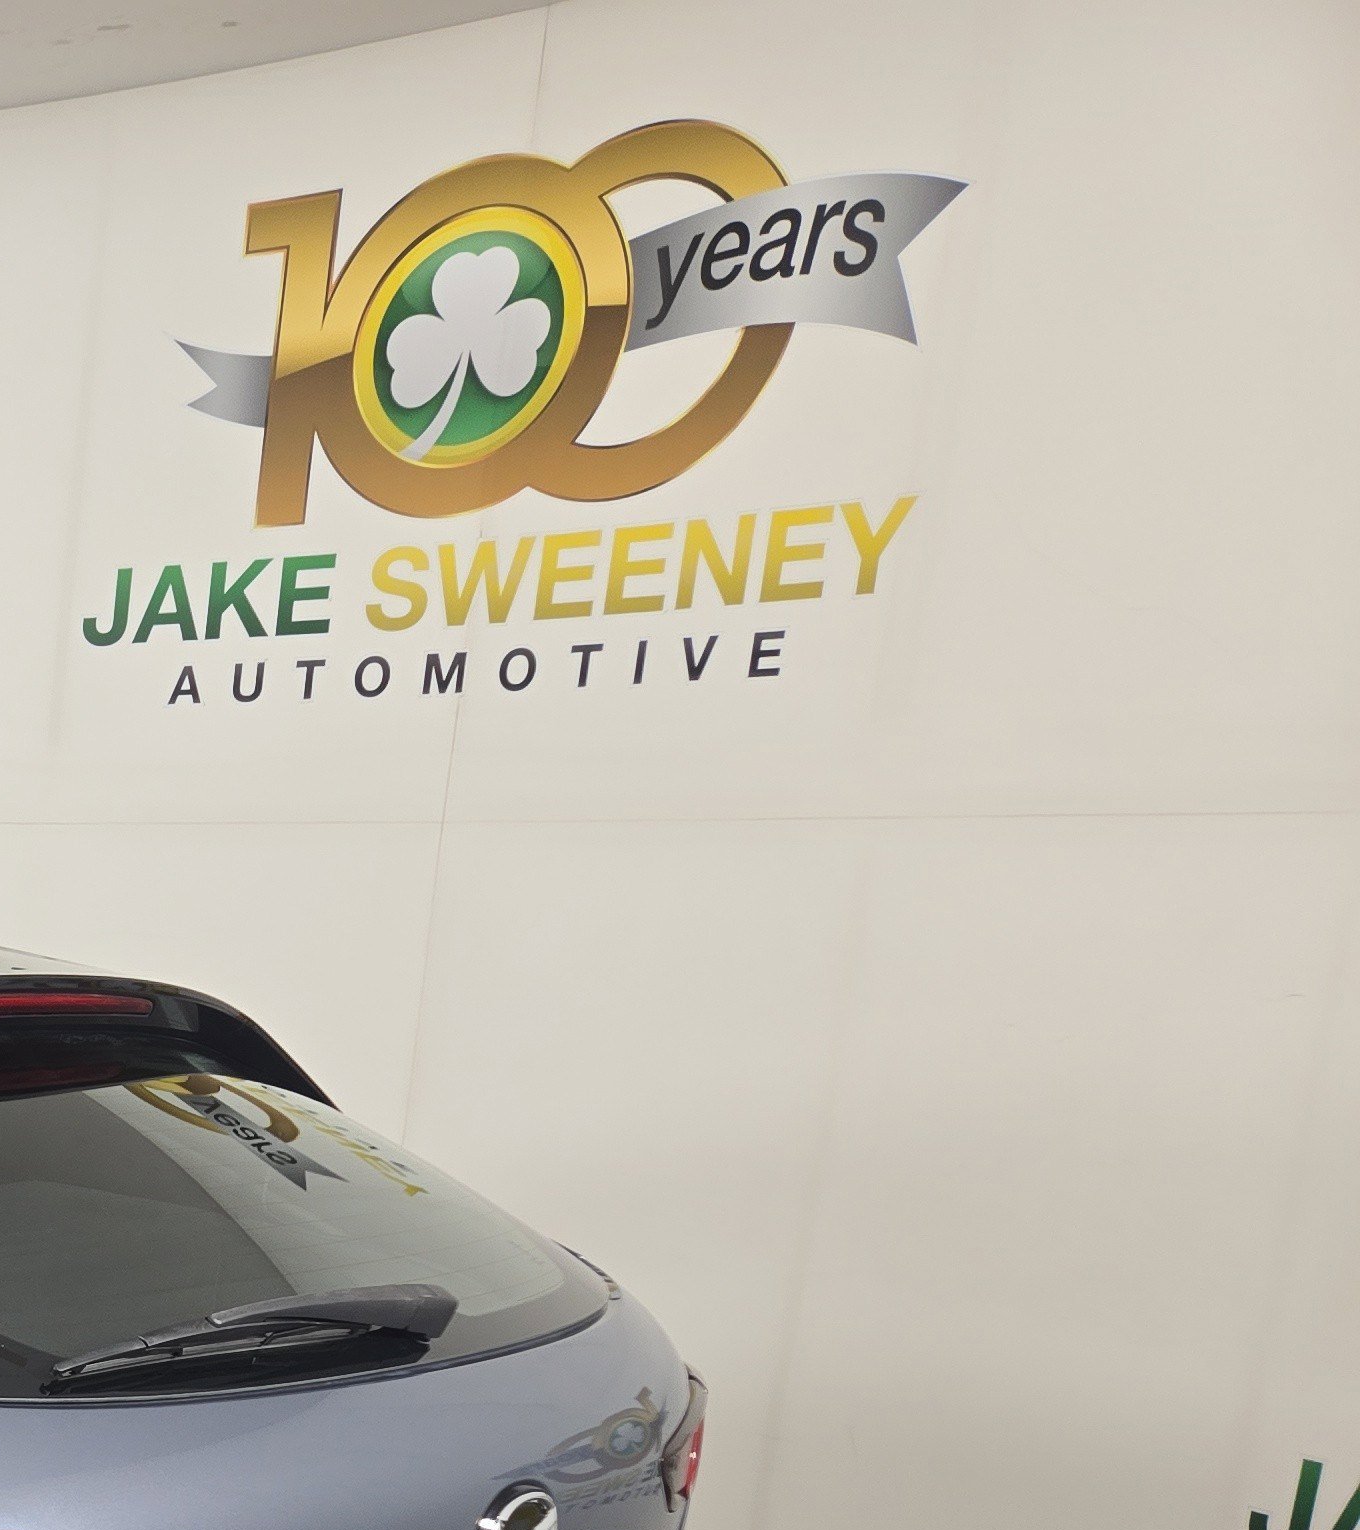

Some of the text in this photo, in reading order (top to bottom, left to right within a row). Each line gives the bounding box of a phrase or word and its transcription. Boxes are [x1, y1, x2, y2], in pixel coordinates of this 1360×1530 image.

[645, 196, 887, 332] years
[81, 494, 919, 647] JAKE SWEENEY
[167, 629, 786, 706] AUTOMOTIVE
